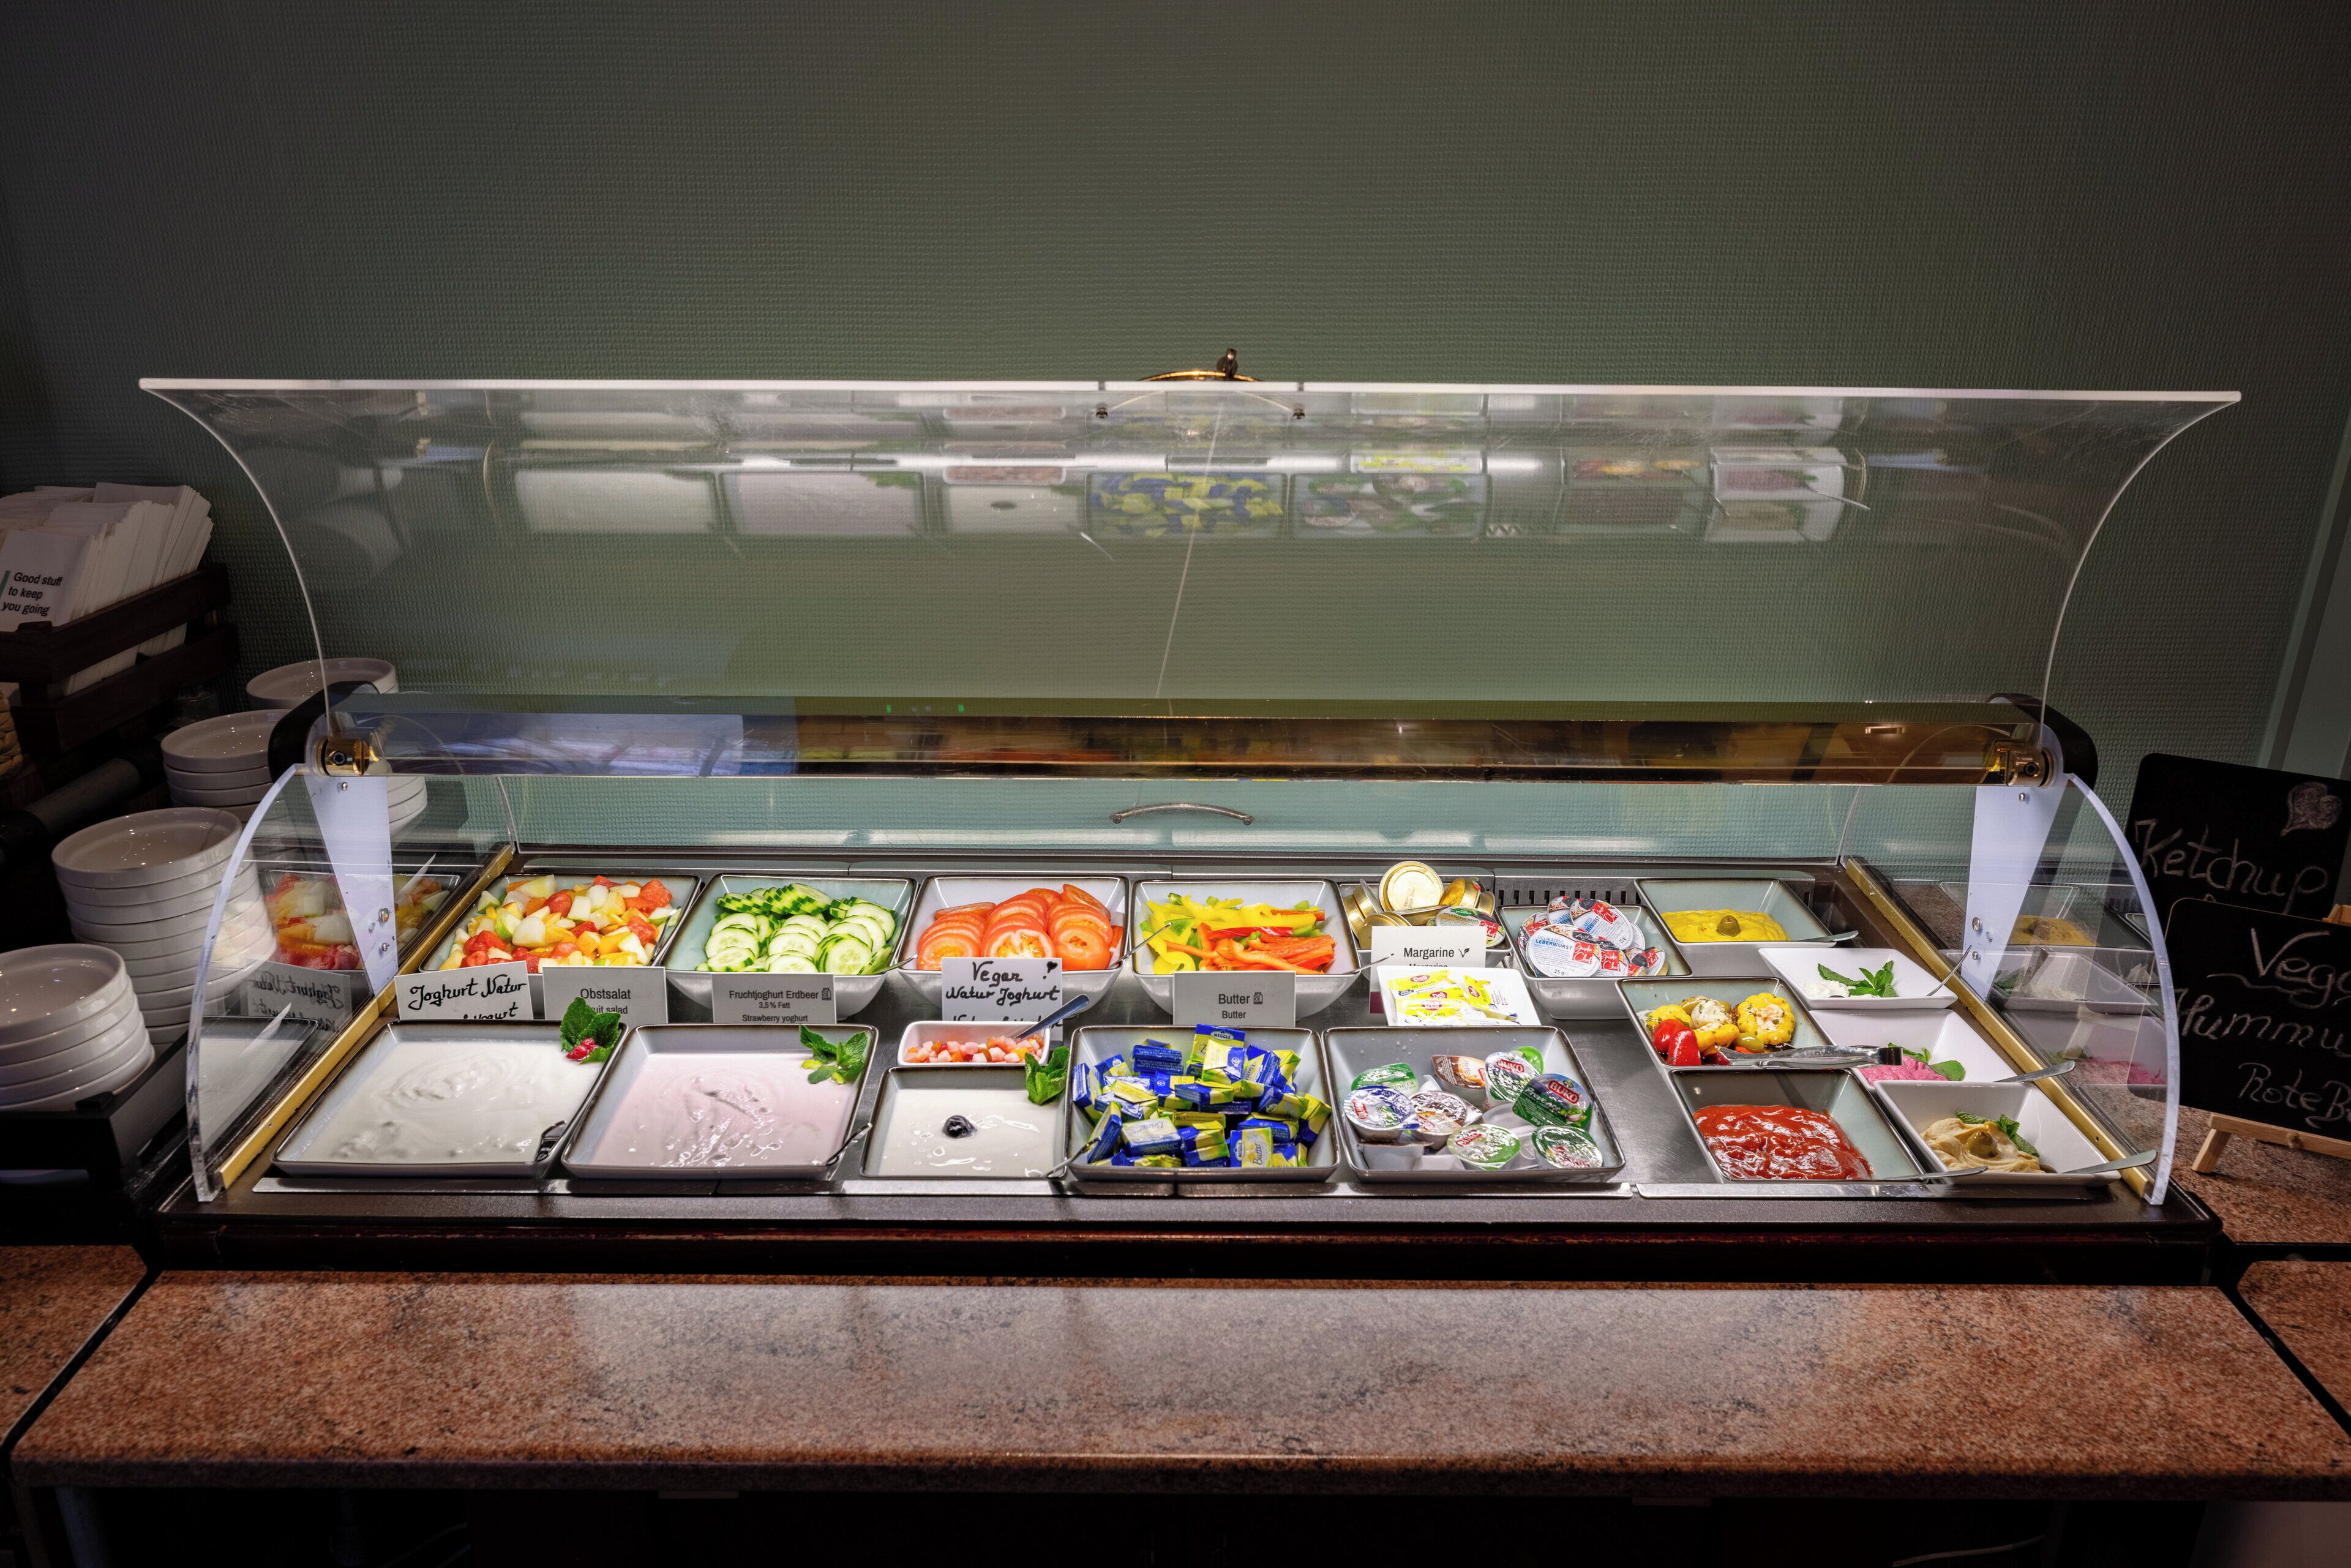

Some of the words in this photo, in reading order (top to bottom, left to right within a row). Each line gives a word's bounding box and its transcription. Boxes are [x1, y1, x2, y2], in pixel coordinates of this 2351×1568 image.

[13, 572, 41, 584] Good
[42, 576, 63, 587] stuff
[8, 586, 18, 596] to
[20, 587, 43, 601] keep
[1, 602, 21, 612] you
[21, 604, 50, 617] going
[2134, 819, 2327, 915] Ketchup
[1584, 916, 1601, 932] BERWURST
[1487, 929, 1496, 939] hef
[1537, 935, 1564, 943] DELIKATESS
[1535, 939, 1573, 950] LEBERWURST
[1403, 947, 1455, 960] Margarine
[1573, 951, 1593, 965] Chef
[1602, 960, 1622, 972] Chef
[972, 960, 1024, 988] Vegan
[408, 977, 479, 1011] Joghurt
[481, 973, 527, 998] Natur
[580, 988, 632, 1000] Obstsalat
[729, 990, 784, 1000] Fruchtjoghurt
[786, 990, 819, 999] Erdbeer
[945, 986, 995, 1000] Natur
[996, 985, 1060, 1007] Joghurt
[1218, 993, 1250, 1005] Butter
[591, 1005, 604, 1014] uit
[606, 1005, 628, 1015] salad
[1221, 1010, 1247, 1019] Butter
[741, 1014, 780, 1023] Strawberry
[781, 1015, 808, 1023] yoghurt
[2174, 987, 2351, 1058] Hummu
[1550, 1081, 1578, 1103] BUKO
[2238, 1062, 2322, 1112] Rote
[1253, 1142, 1263, 1166] Butter
